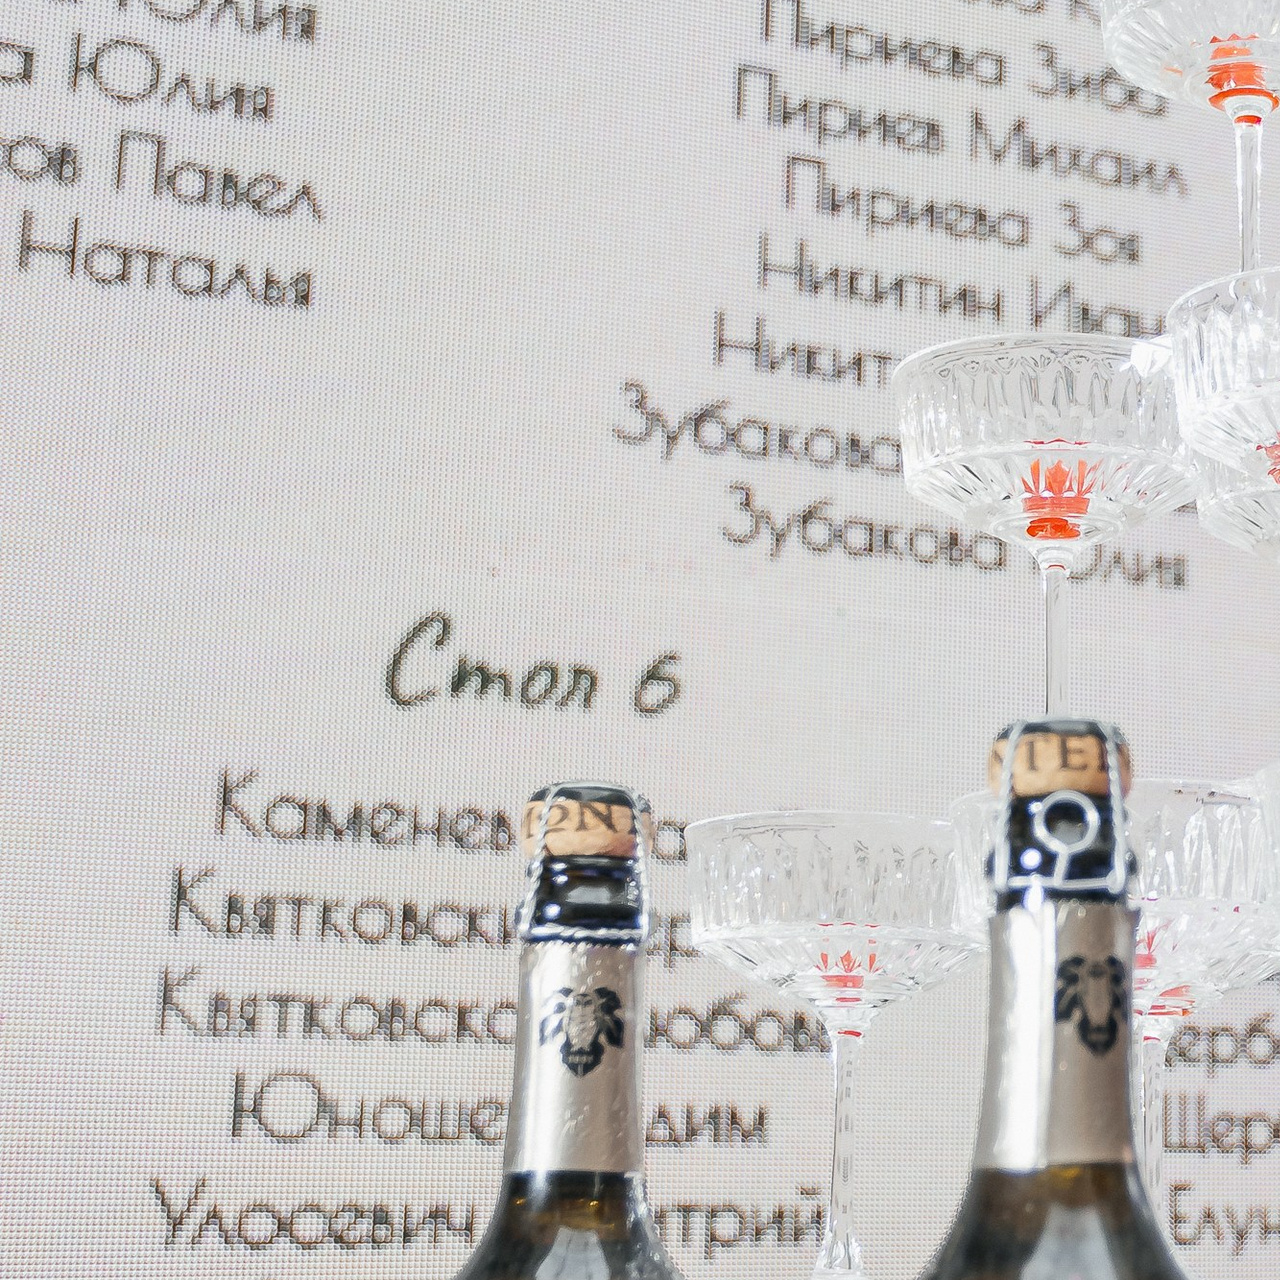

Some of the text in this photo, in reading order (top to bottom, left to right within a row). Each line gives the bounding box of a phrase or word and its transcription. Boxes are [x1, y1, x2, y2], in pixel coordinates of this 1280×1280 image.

[71, 31, 276, 123] Юлия
[0, 128, 325, 224] ов Павел
[734, 62, 1192, 200] Пириев Михаил
[785, 154, 1146, 264] Пириева Зоя
[17, 210, 316, 312] Наталья
[758, 231, 1006, 324] Никитин
[712, 312, 902, 386] Никит
[722, 482, 1008, 572] Зубакова
[385, 609, 684, 717] Стол 6
[231, 1071, 772, 1147] Юноше дим
[149, 1175, 826, 1263] Улосевич трий
